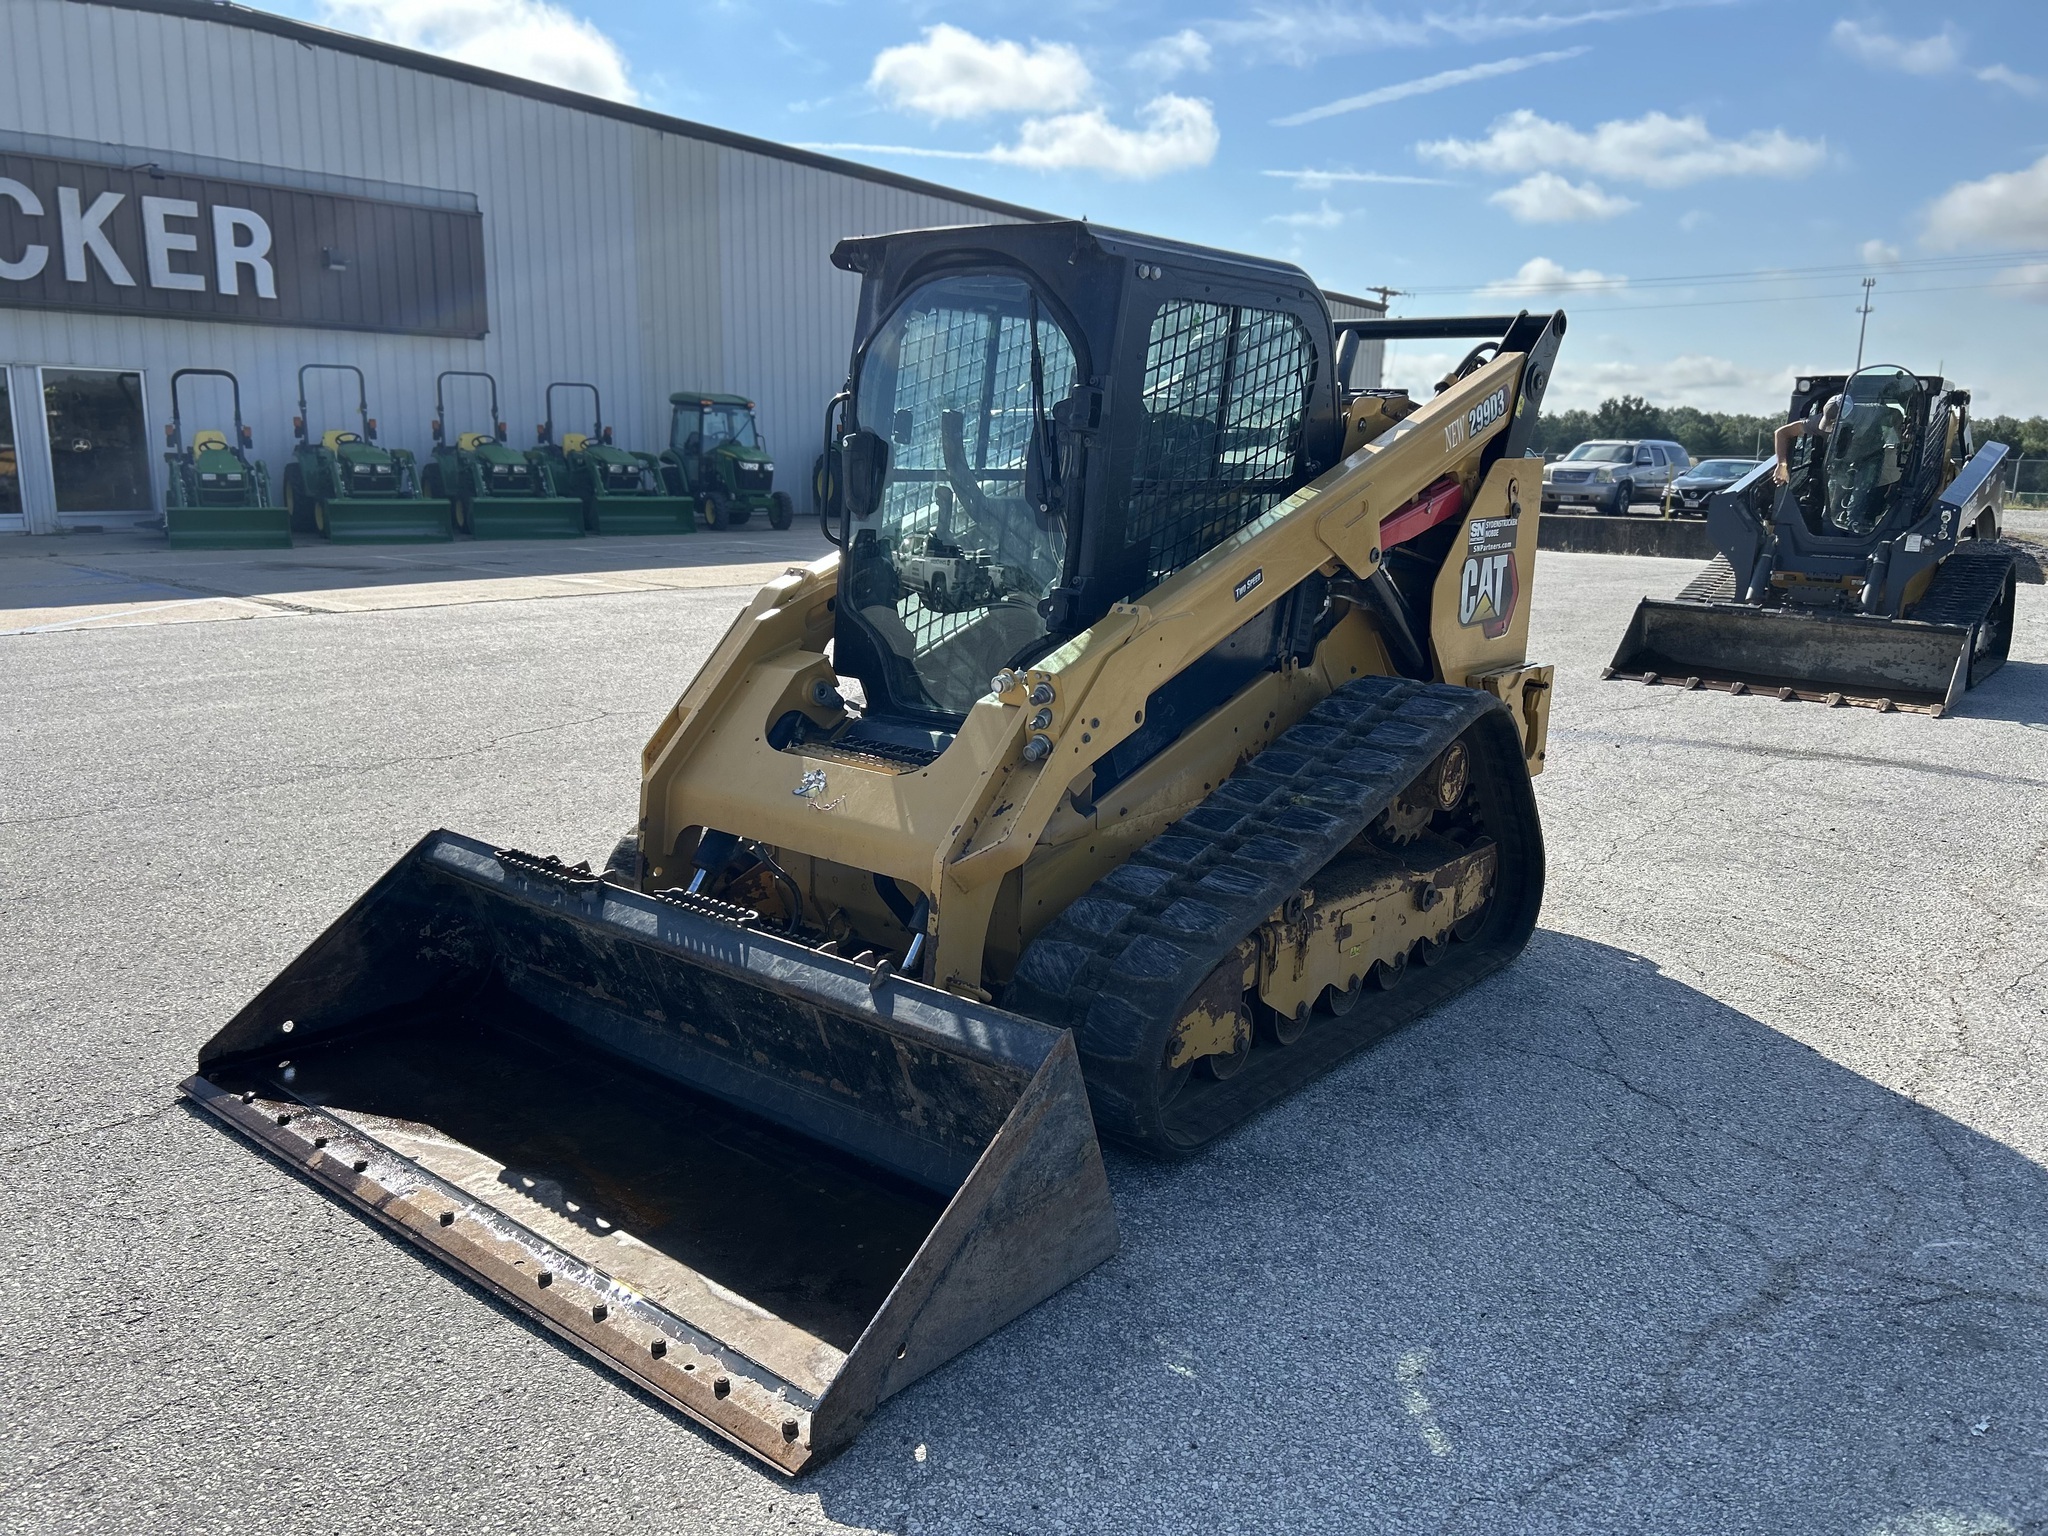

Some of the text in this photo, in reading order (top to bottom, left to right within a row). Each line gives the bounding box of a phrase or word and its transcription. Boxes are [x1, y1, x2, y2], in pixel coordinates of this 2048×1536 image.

[0, 177, 277, 299] CKER
[1469, 389, 1505, 438] 299D3
[1470, 522, 1485, 537] SN
[1460, 554, 1509, 624] CAT
